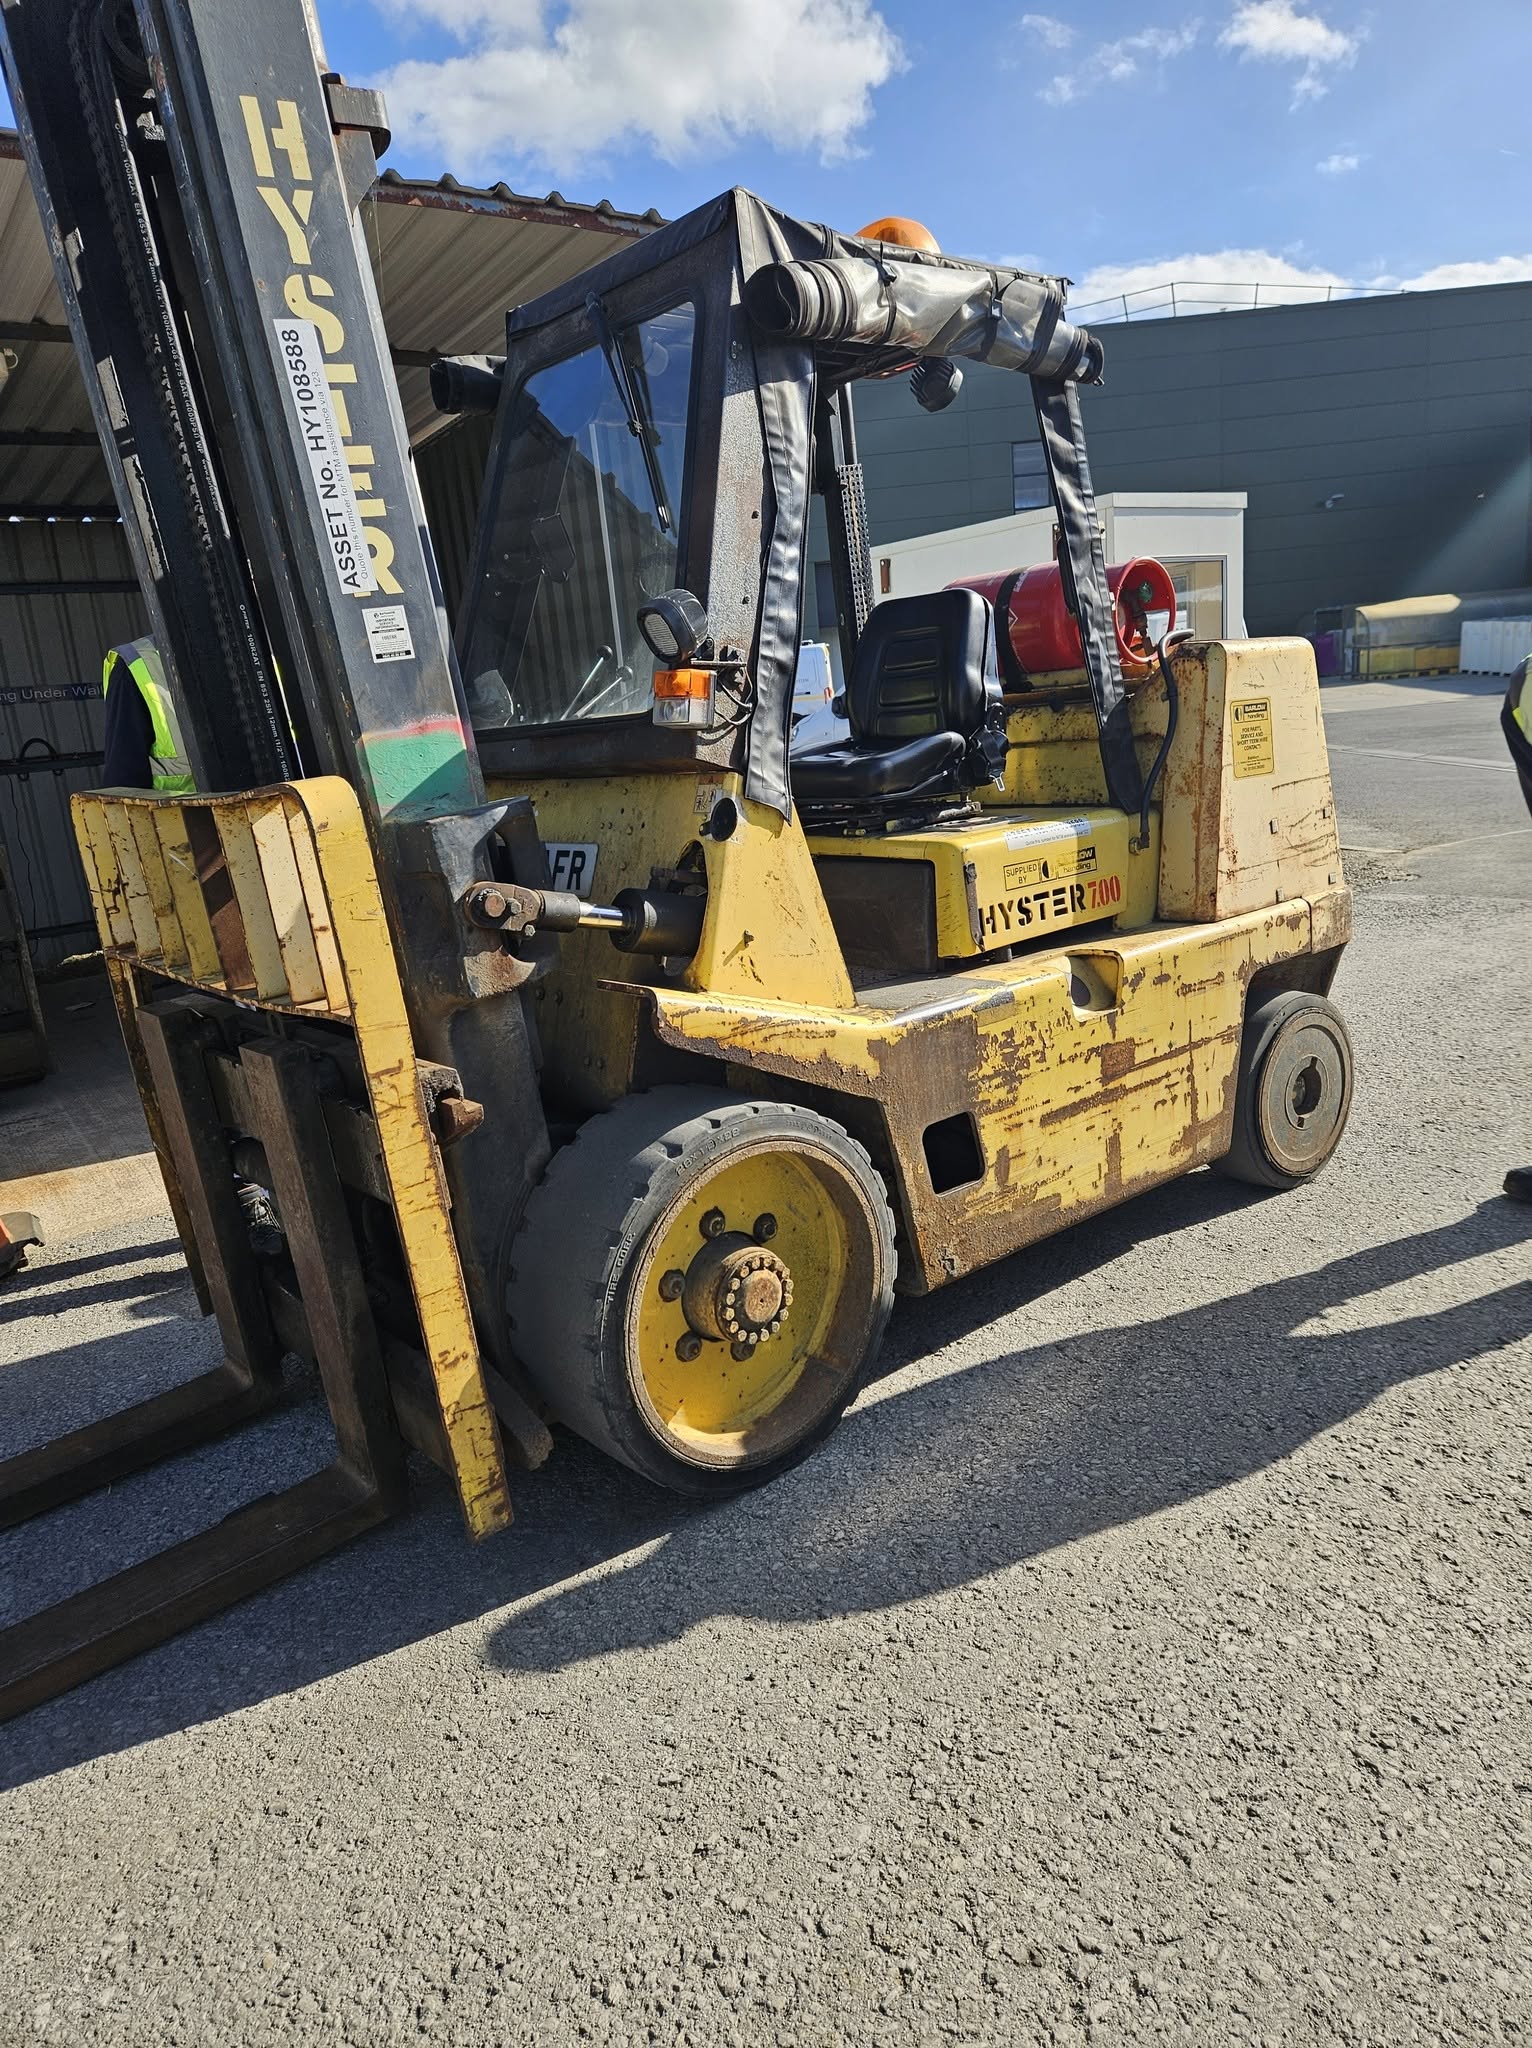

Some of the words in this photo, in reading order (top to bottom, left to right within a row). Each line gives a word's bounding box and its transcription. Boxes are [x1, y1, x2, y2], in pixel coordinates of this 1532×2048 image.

[133, 202, 142, 216] EN
[141, 236, 151, 254] 2SN
[146, 256, 158, 282] 12mm
[195, 439, 204, 454] WP
[239, 95, 404, 597] HYSTER
[281, 329, 327, 452] HY108588
[310, 367, 322, 389] 123.
[316, 390, 325, 405] via
[320, 406, 338, 457] assistance
[319, 459, 338, 500] No.
[332, 458, 344, 483] MTM
[338, 483, 348, 497] for
[342, 497, 357, 532] number
[326, 507, 361, 588] ASSET
[350, 533, 361, 551] this
[355, 551, 369, 579] Quote
[21, 688, 67, 700] Under
[246, 633, 260, 666] 100R2AT
[255, 670, 264, 681] EN
[263, 697, 273, 714] 2SN
[268, 715, 279, 737] 12mm
[546, 850, 587, 890] FR
[1006, 863, 1037, 878] SUPPLIED
[1018, 876, 1028, 884] BY
[1063, 861, 1092, 873] handling
[978, 883, 1087, 937] HYSTER
[1088, 875, 1122, 909] 7.00
[606, 1273, 620, 1304] TIRE
